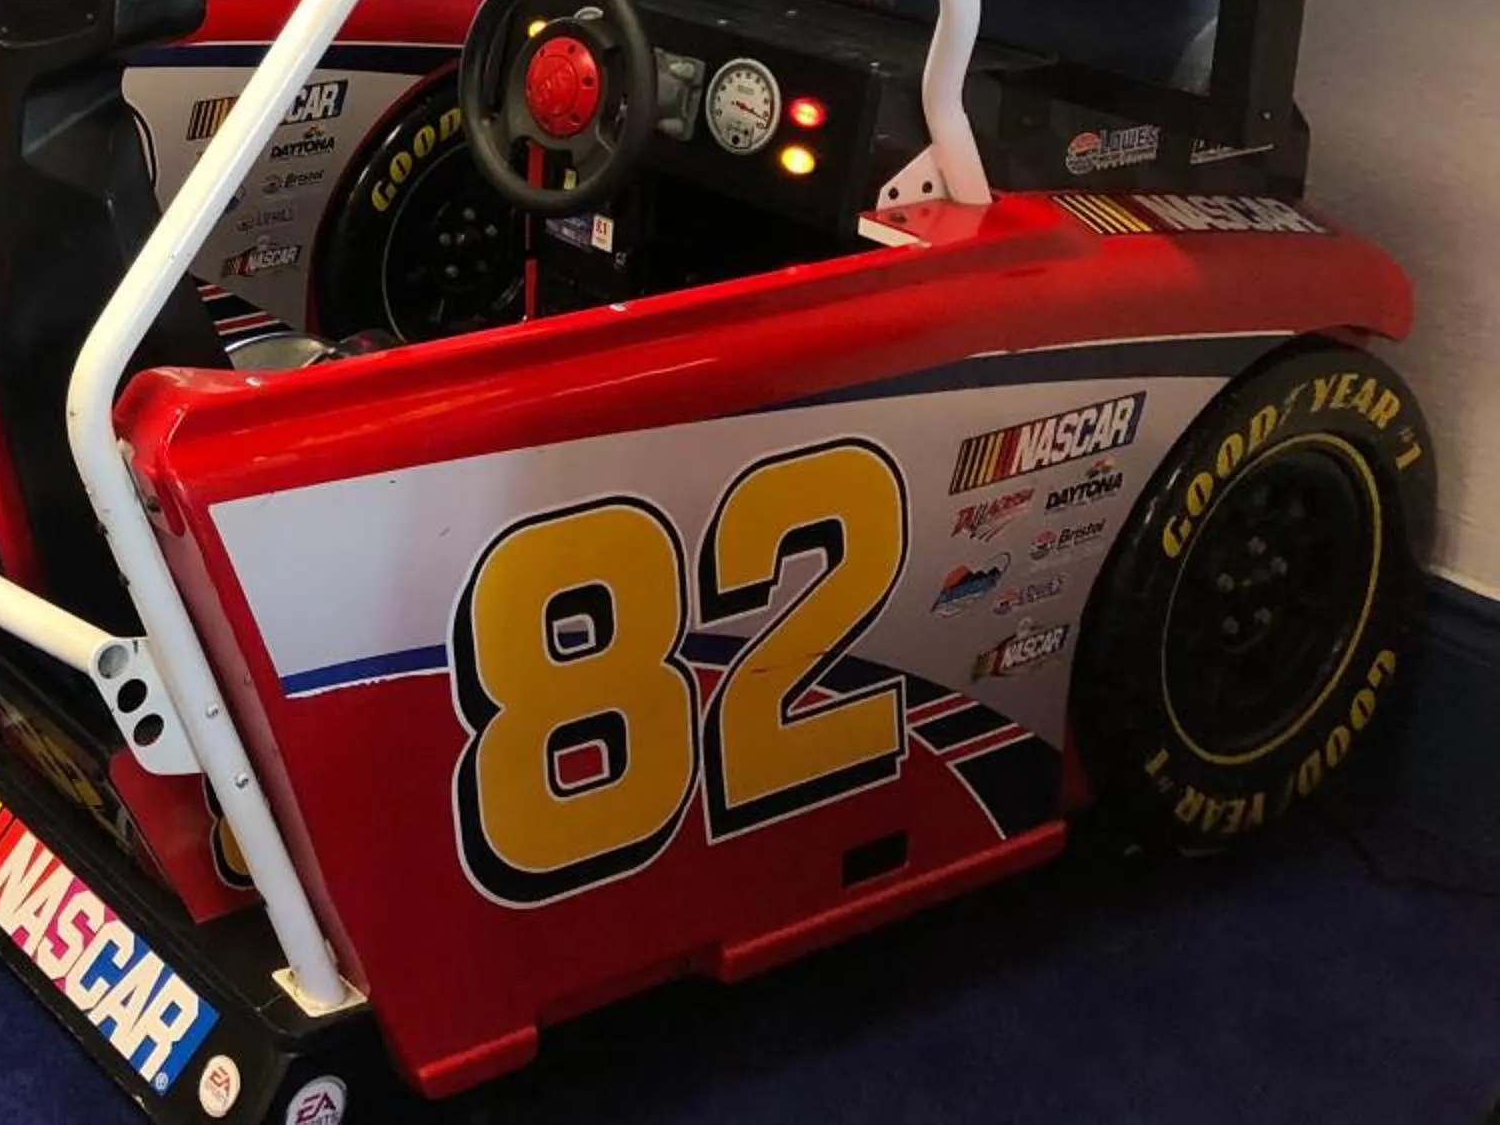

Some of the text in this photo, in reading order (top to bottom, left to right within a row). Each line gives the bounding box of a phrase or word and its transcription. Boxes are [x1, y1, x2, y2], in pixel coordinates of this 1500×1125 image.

[1016, 396, 1136, 472] NASCAR
[1045, 472, 1123, 510] DAYTONA
[448, 434, 911, 909] 82
[297, 1092, 336, 1124] EA
